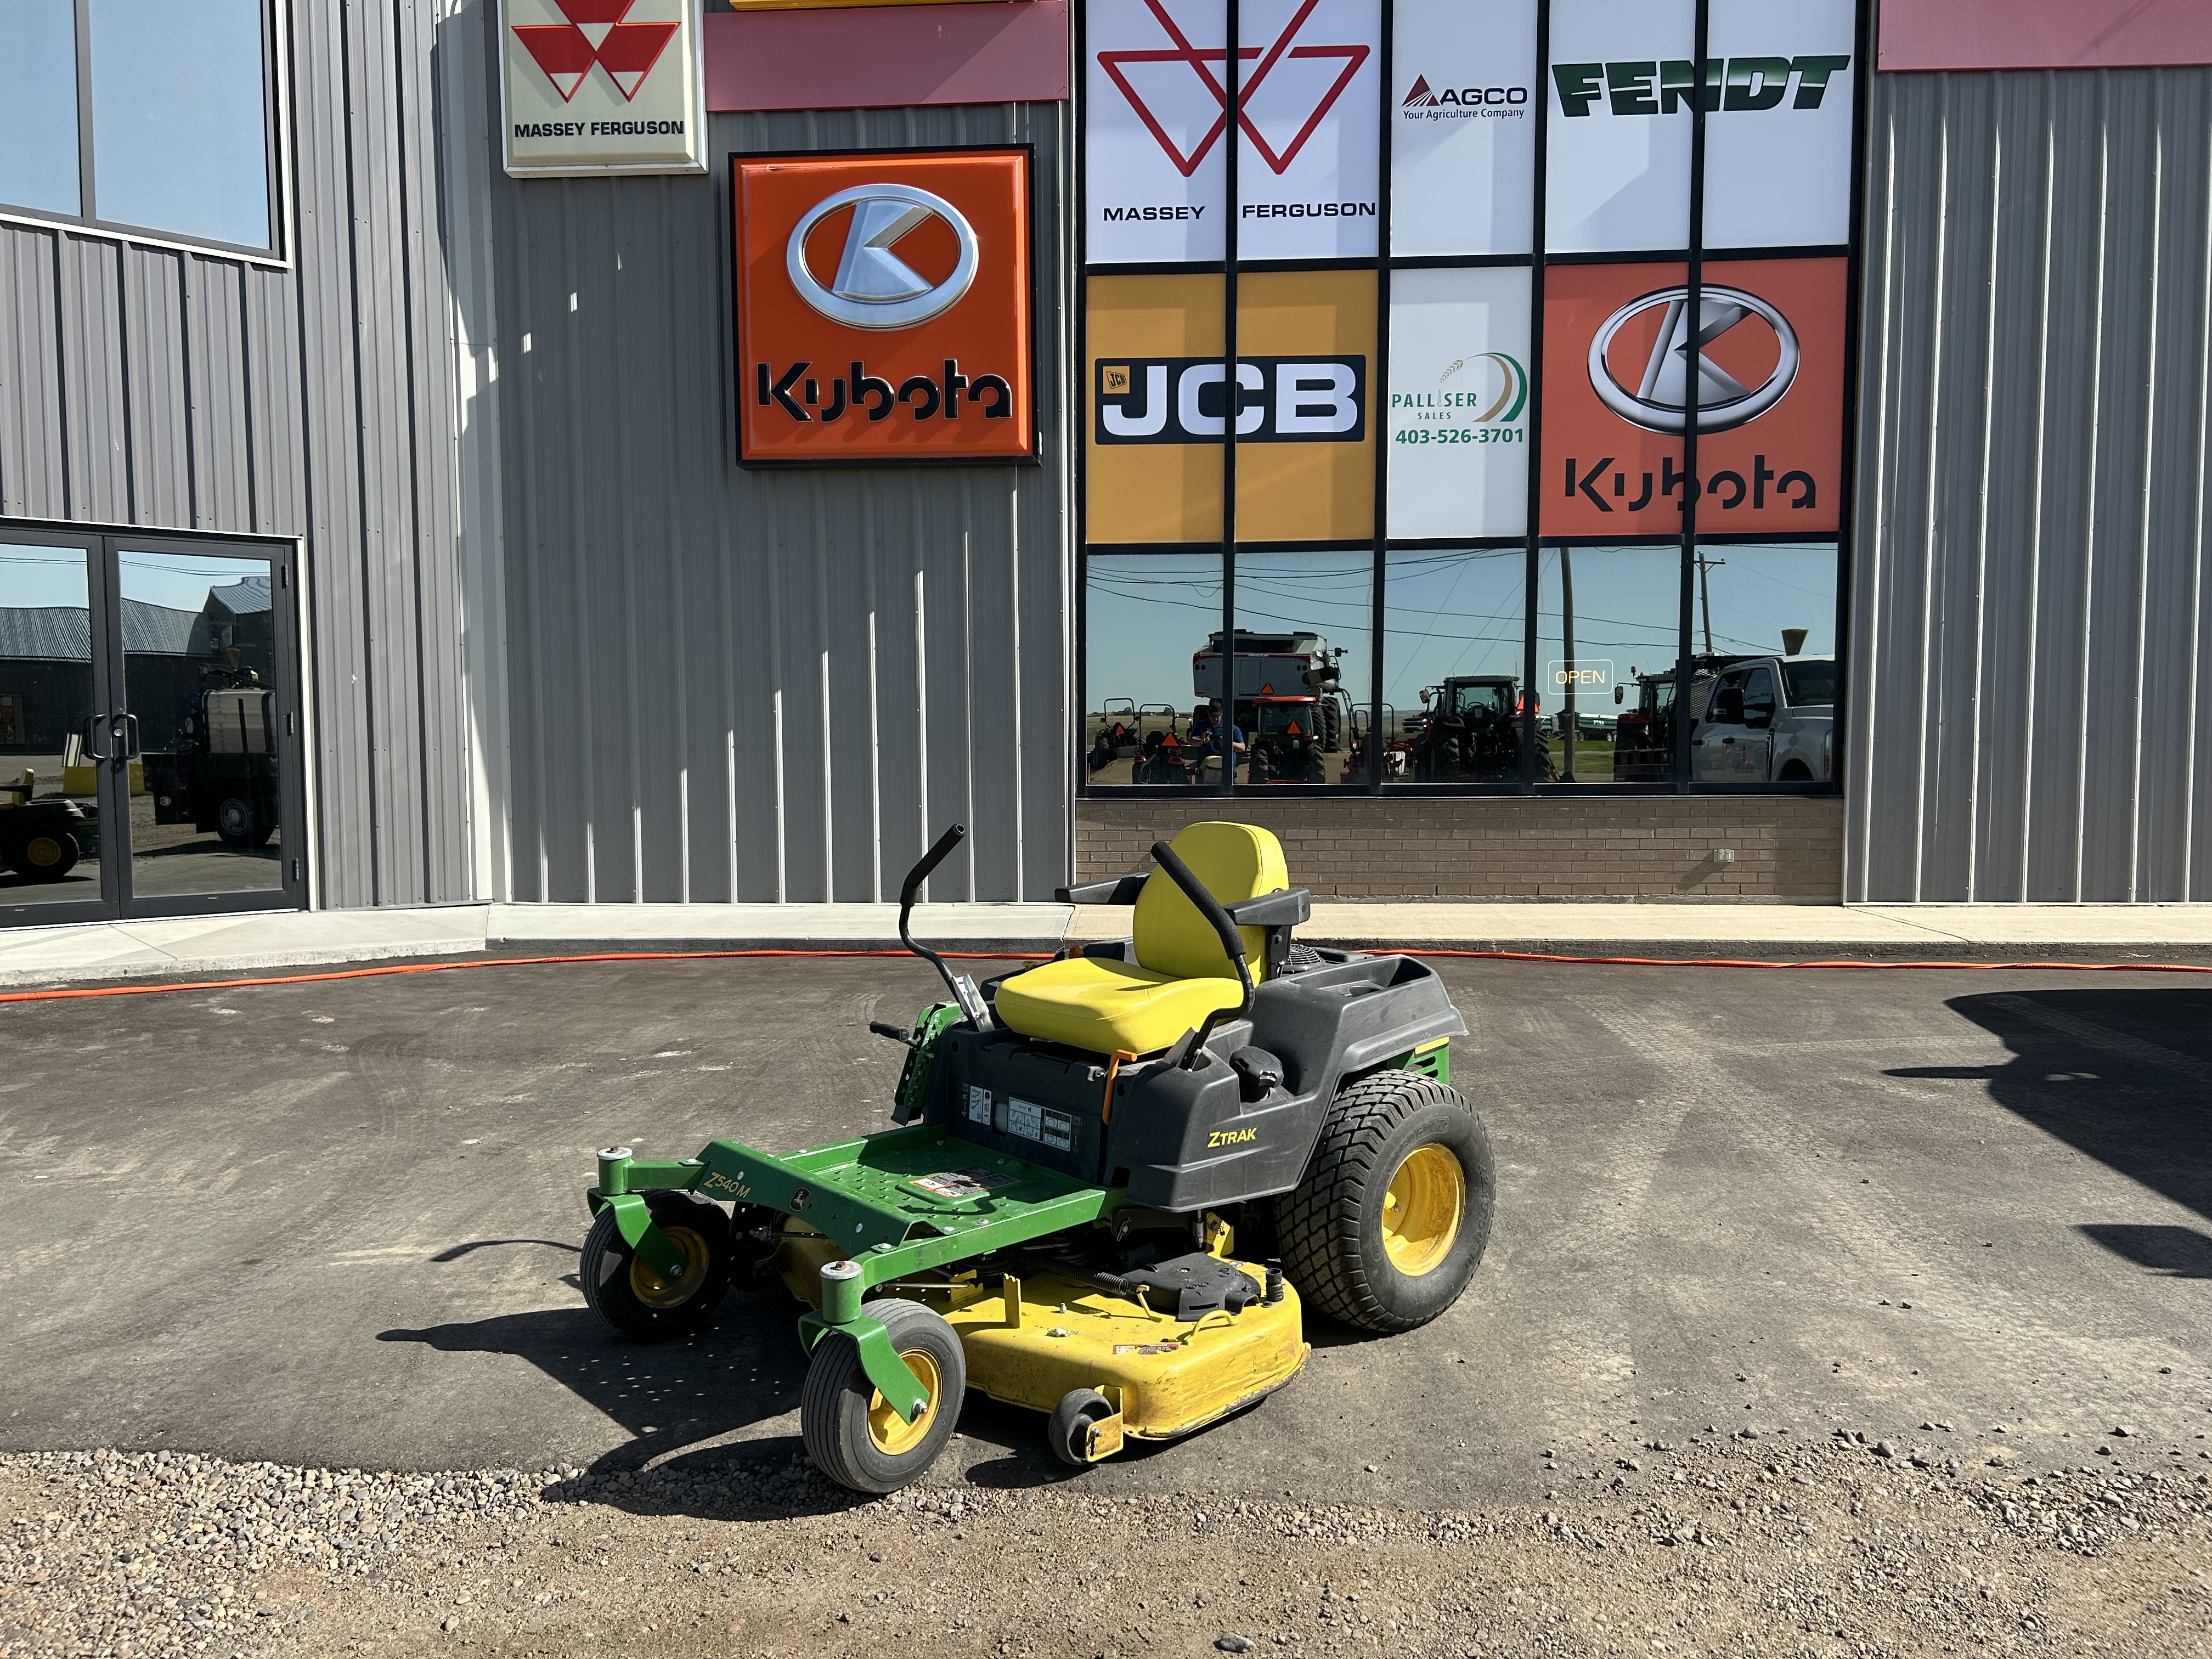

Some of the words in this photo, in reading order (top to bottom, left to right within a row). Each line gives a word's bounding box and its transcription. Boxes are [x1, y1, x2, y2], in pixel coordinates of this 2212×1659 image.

[1551, 55, 1851, 117] FENDT
[1439, 87, 1528, 106] AGCO
[1403, 110, 1424, 119] Your
[1426, 109, 1478, 121] Agriculture
[1481, 108, 1525, 119] Company
[515, 122, 585, 138] MASSEY
[591, 120, 684, 136] FERGUSON
[1103, 206, 1206, 221] MASSEY
[1242, 202, 1376, 218] FERGUSON
[1109, 373, 1125, 387] JCB
[755, 358, 1013, 422] Kubota
[1103, 363, 1358, 436] JCB
[1417, 411, 1452, 420] SALES
[1395, 428, 1523, 444] 403-526-3701
[1565, 455, 1817, 512] Kubota
[1555, 669, 1605, 684] OPEN
[1207, 1127, 1257, 1148] ZTRAK
[703, 1171, 752, 1199] Z540M
